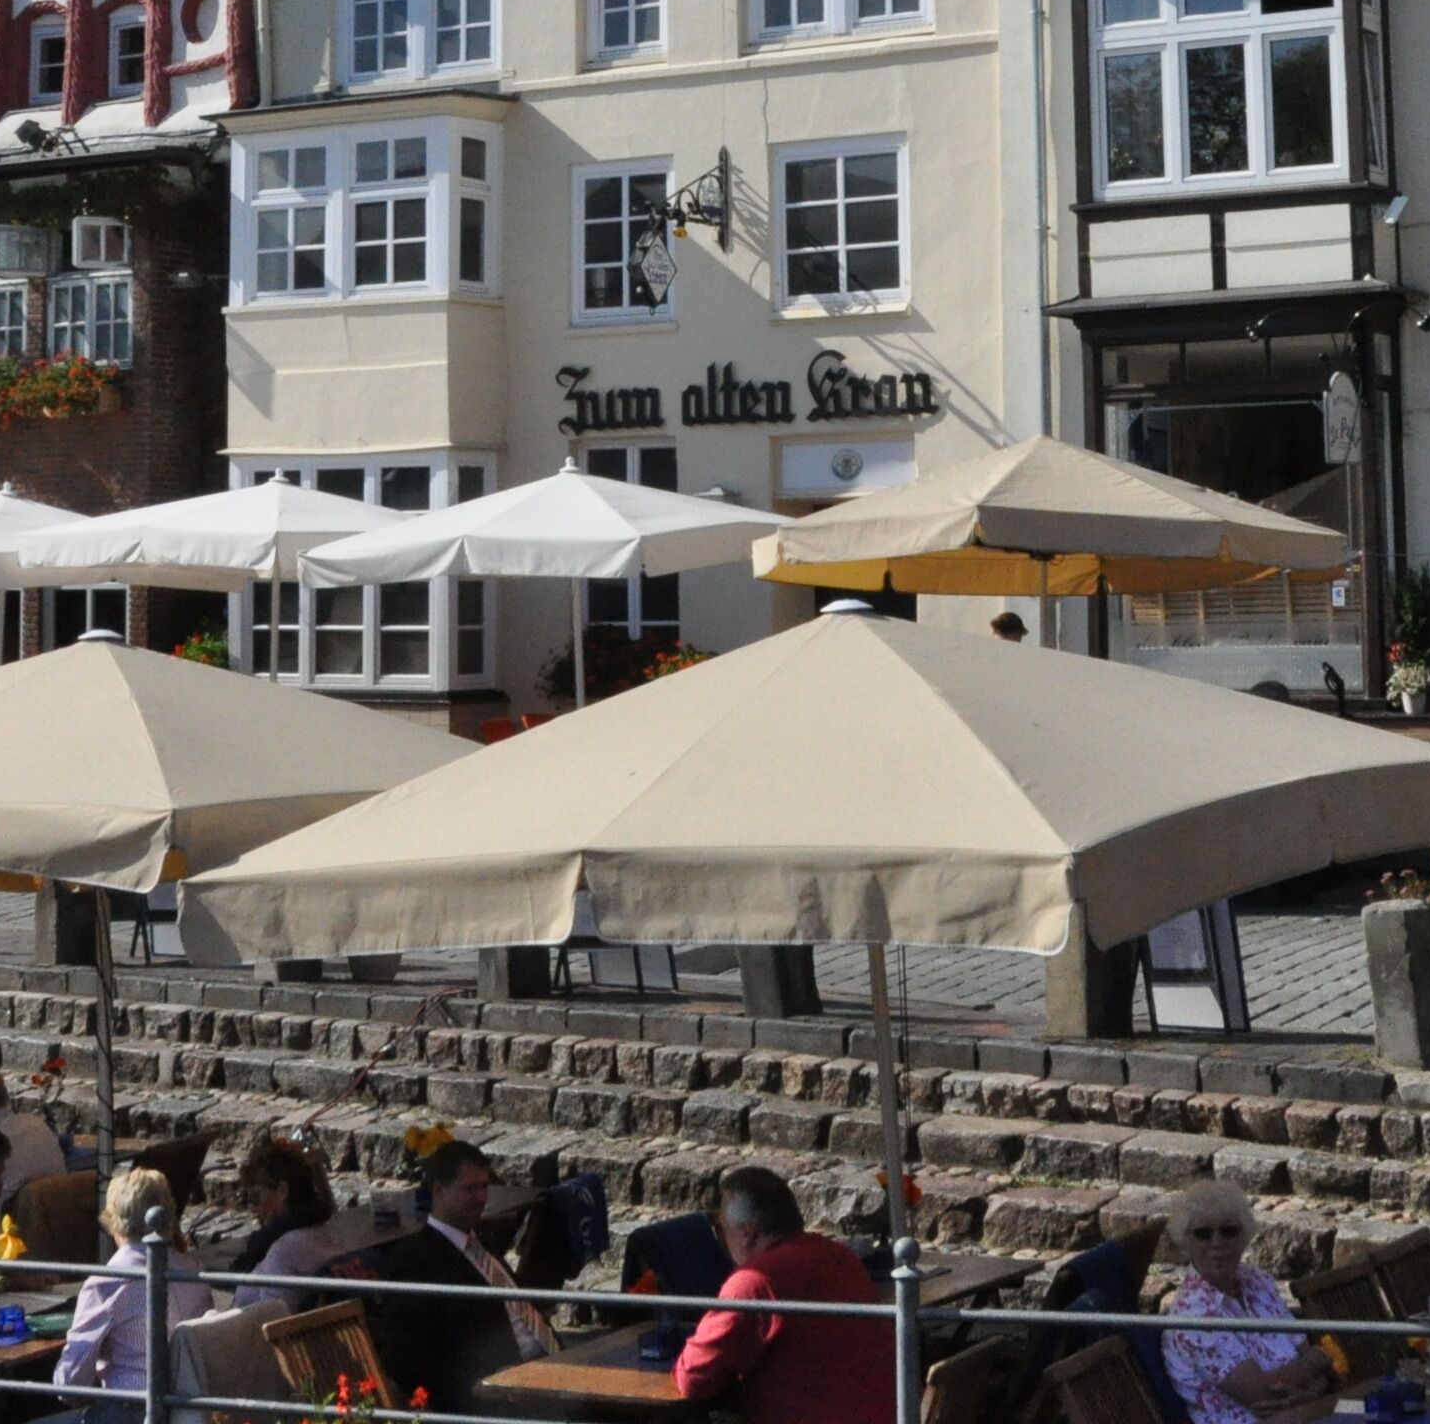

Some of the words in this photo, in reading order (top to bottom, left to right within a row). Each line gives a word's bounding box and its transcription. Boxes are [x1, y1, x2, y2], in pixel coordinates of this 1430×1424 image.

[555, 366, 666, 436] Zum
[680, 361, 796, 427] alten
[806, 349, 940, 421] Kran
